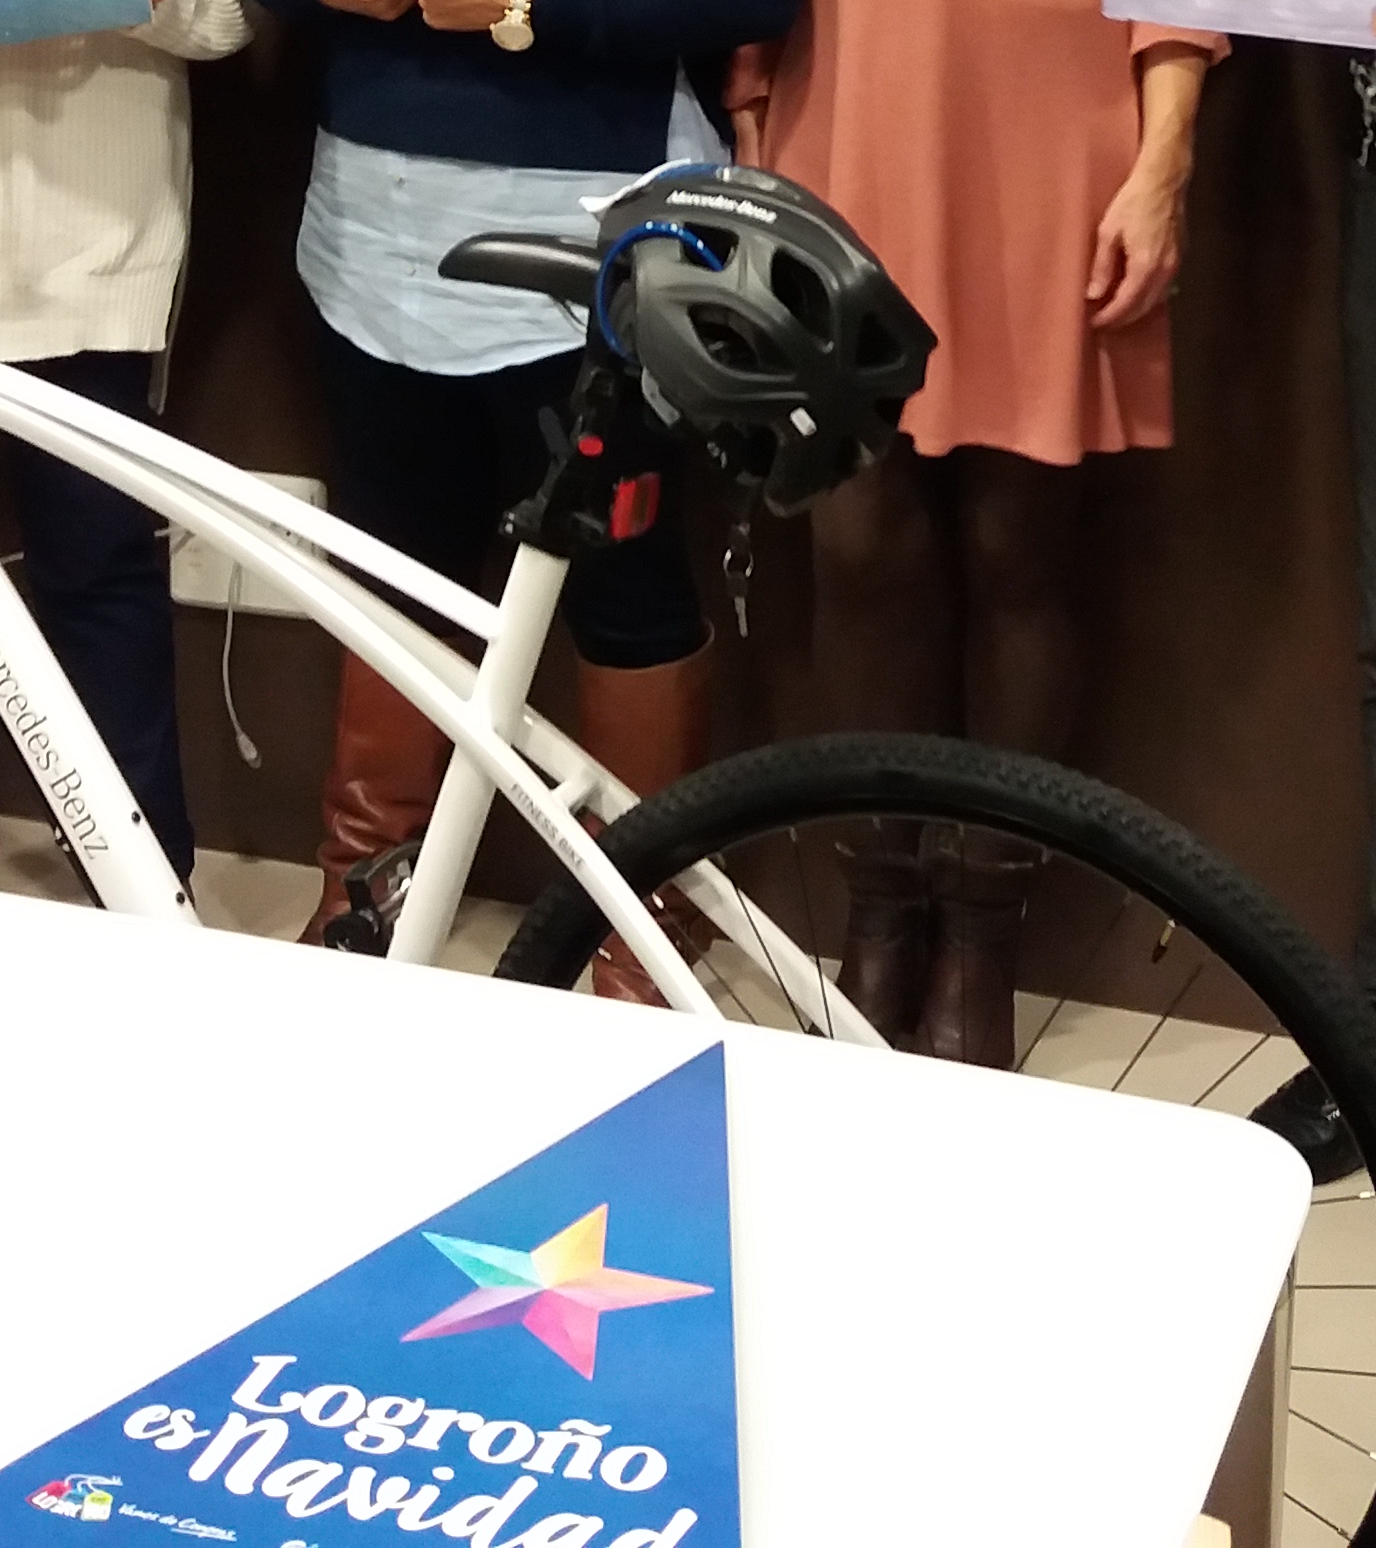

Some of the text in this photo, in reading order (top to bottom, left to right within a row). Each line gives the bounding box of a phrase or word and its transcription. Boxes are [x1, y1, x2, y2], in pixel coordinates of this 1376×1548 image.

[123, 1403, 700, 1548] es Navidad
[230, 1354, 669, 1492] Logroño
